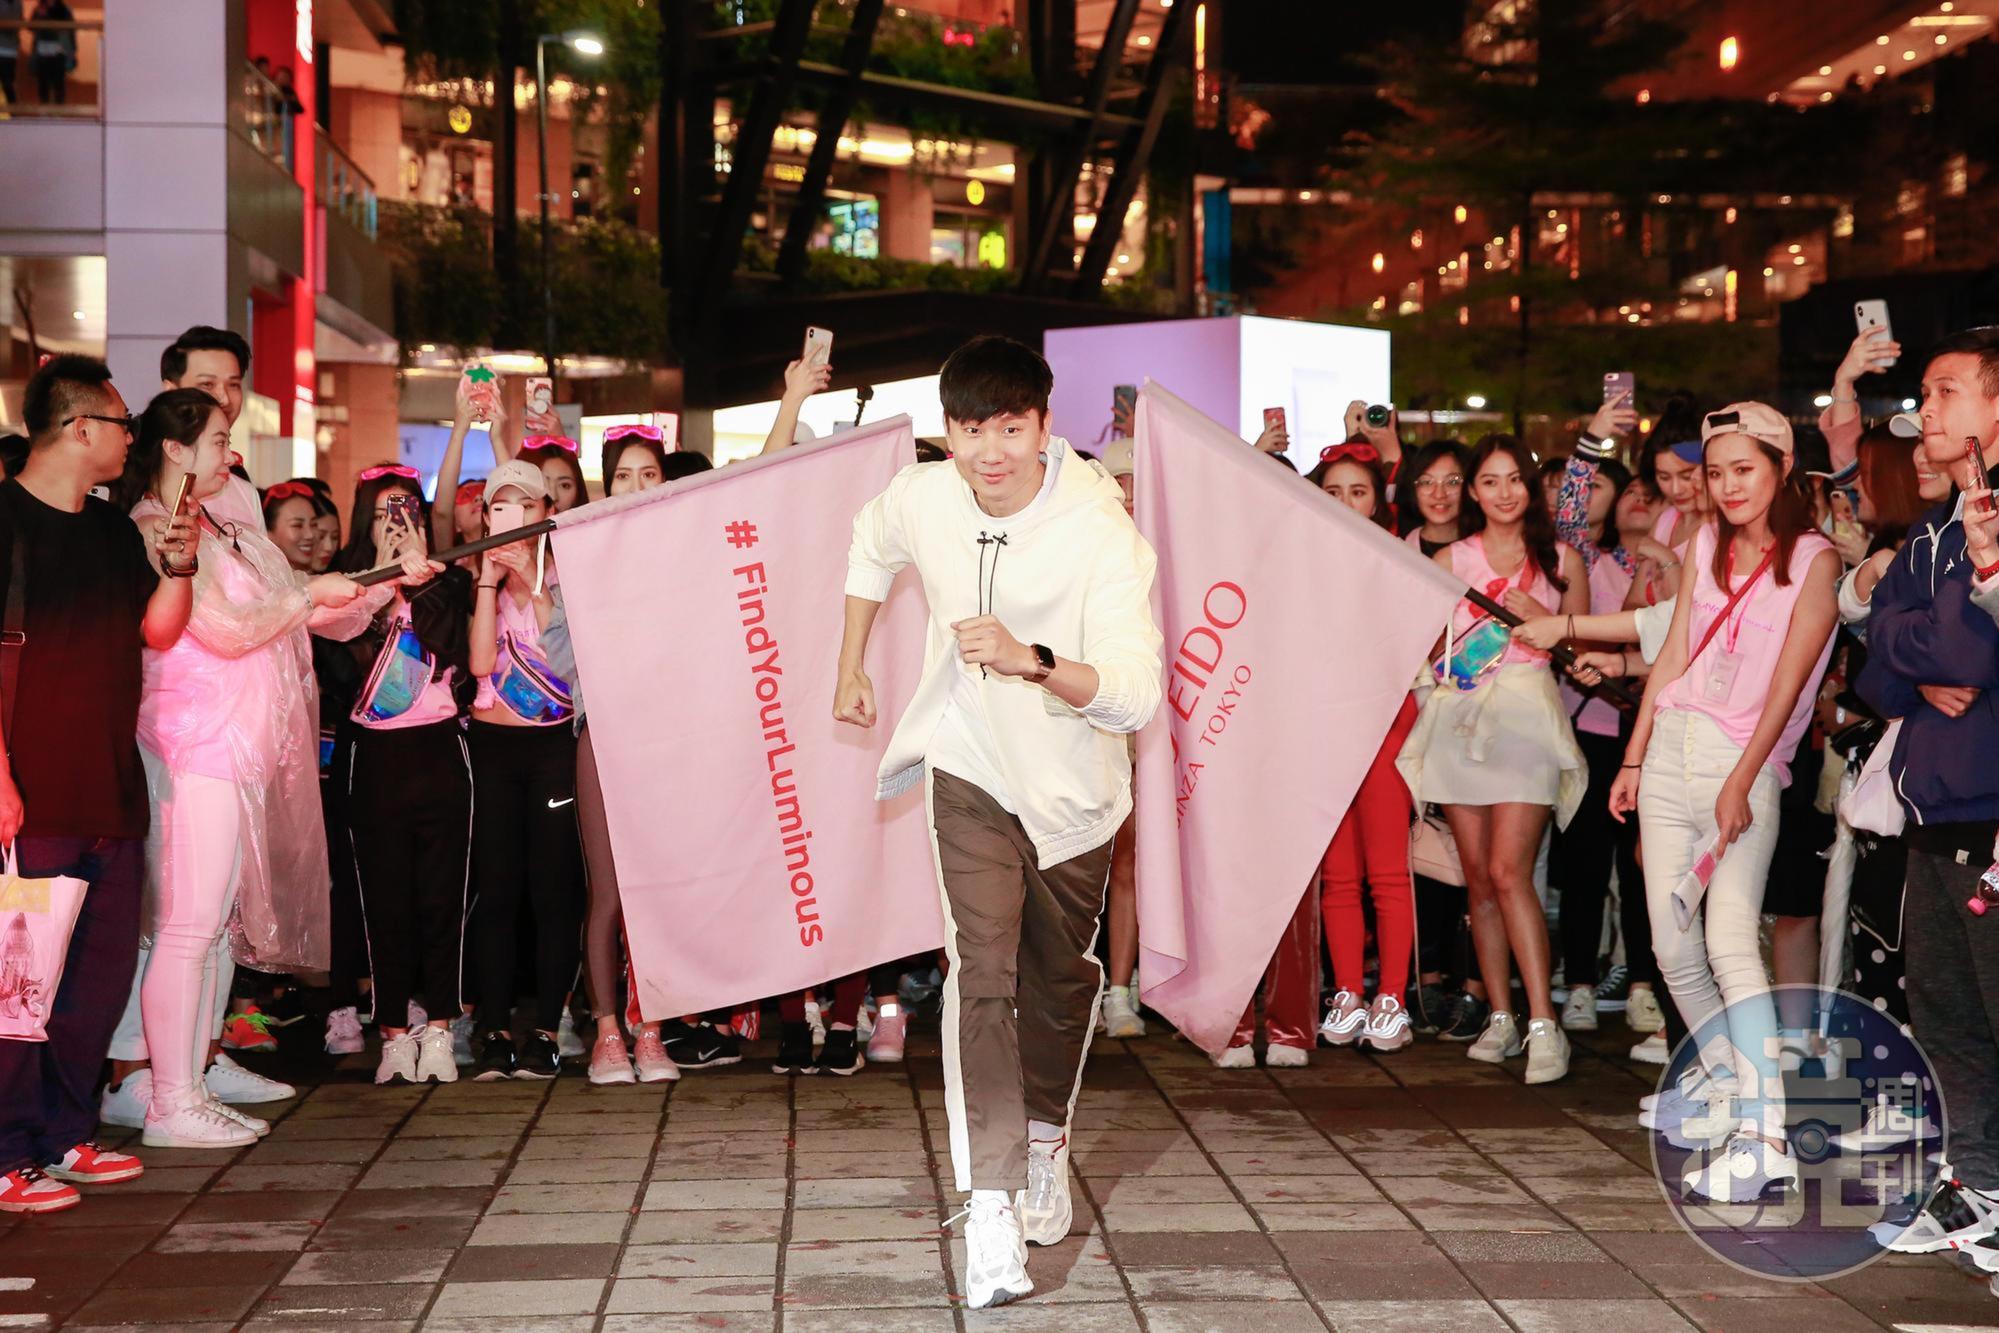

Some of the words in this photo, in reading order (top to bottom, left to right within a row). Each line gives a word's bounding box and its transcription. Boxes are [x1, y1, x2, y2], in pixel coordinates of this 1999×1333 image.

[725, 521, 758, 548] #
[1199, 665, 1252, 747] TOKYO
[734, 562, 823, 947] FindYourLuminous
